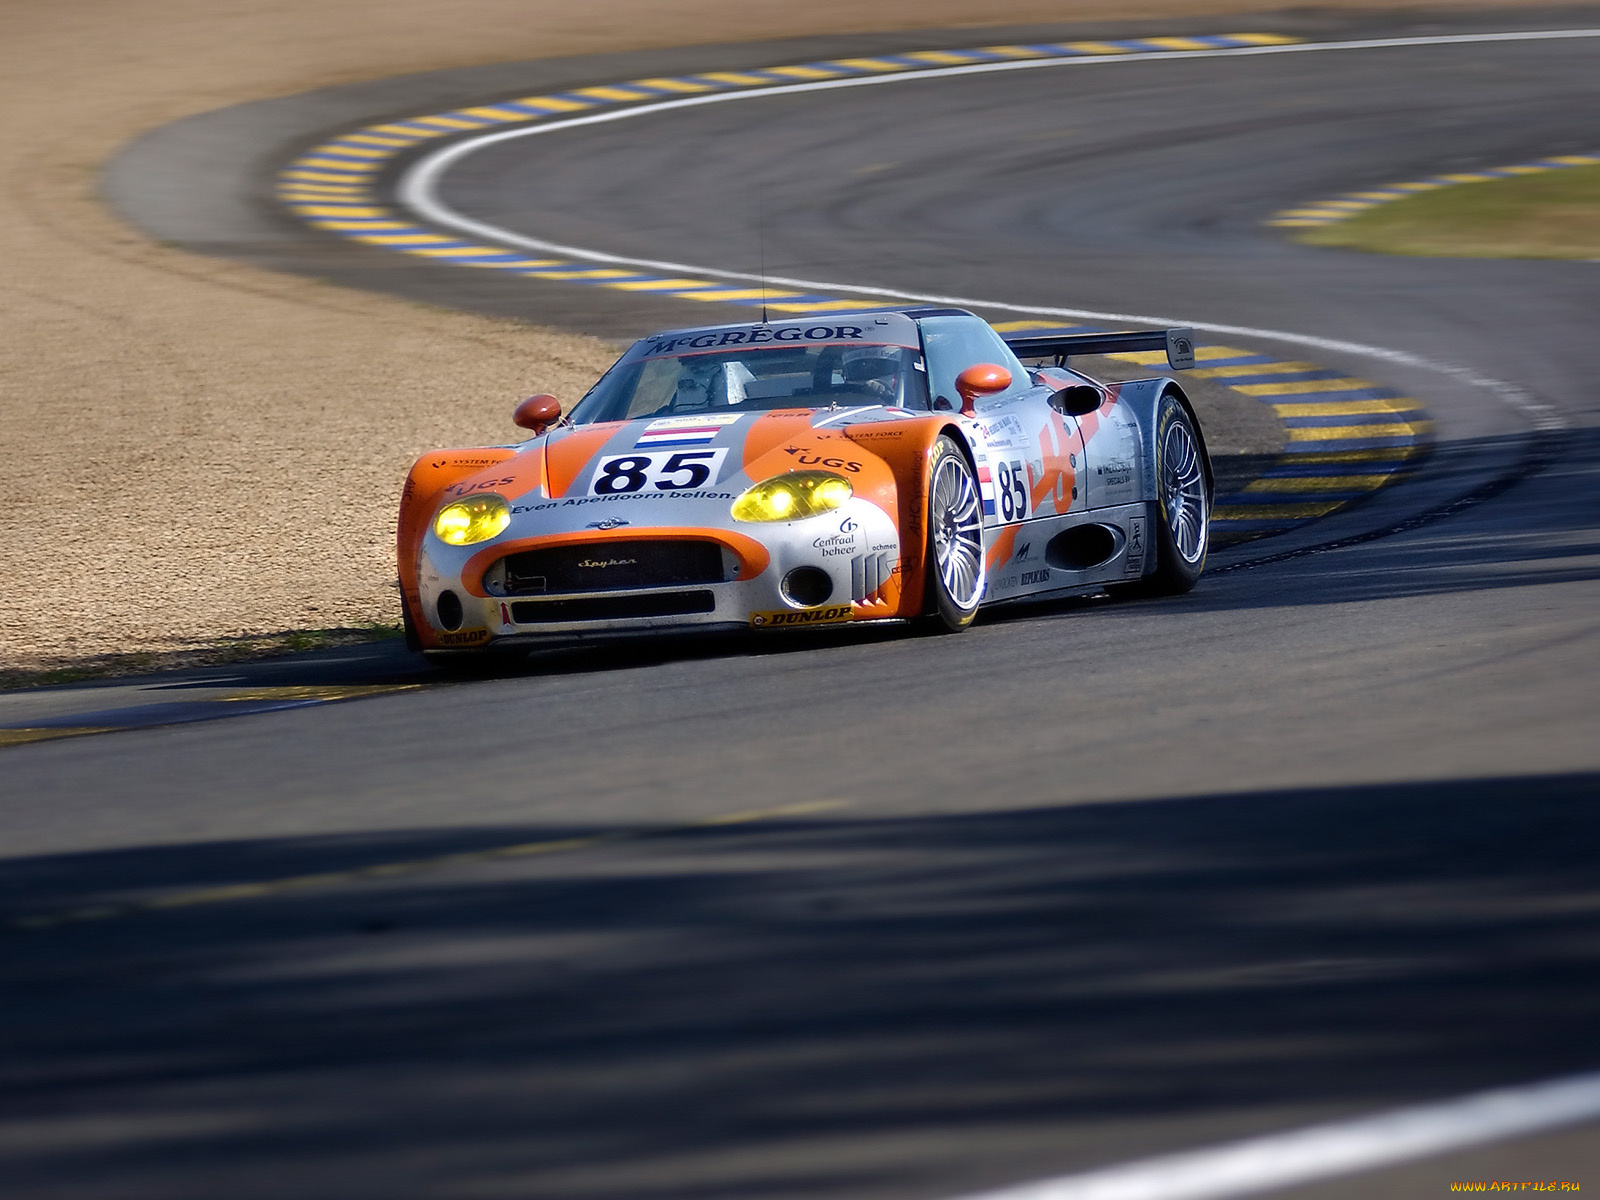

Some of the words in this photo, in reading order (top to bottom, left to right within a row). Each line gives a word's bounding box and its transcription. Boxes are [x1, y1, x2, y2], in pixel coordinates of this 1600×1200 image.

[594, 451, 716, 495] 85
[798, 455, 863, 473] UGS
[457, 476, 516, 495] UGS
[998, 460, 1027, 521] 85
[511, 502, 558, 514] Even
[561, 492, 664, 507] Apeldoorn
[668, 490, 736, 500] bellen.
[812, 534, 855, 549] Centraal
[822, 546, 857, 557] beheer
[769, 606, 852, 625] DUNLOP
[442, 629, 487, 645] DUNLOP
